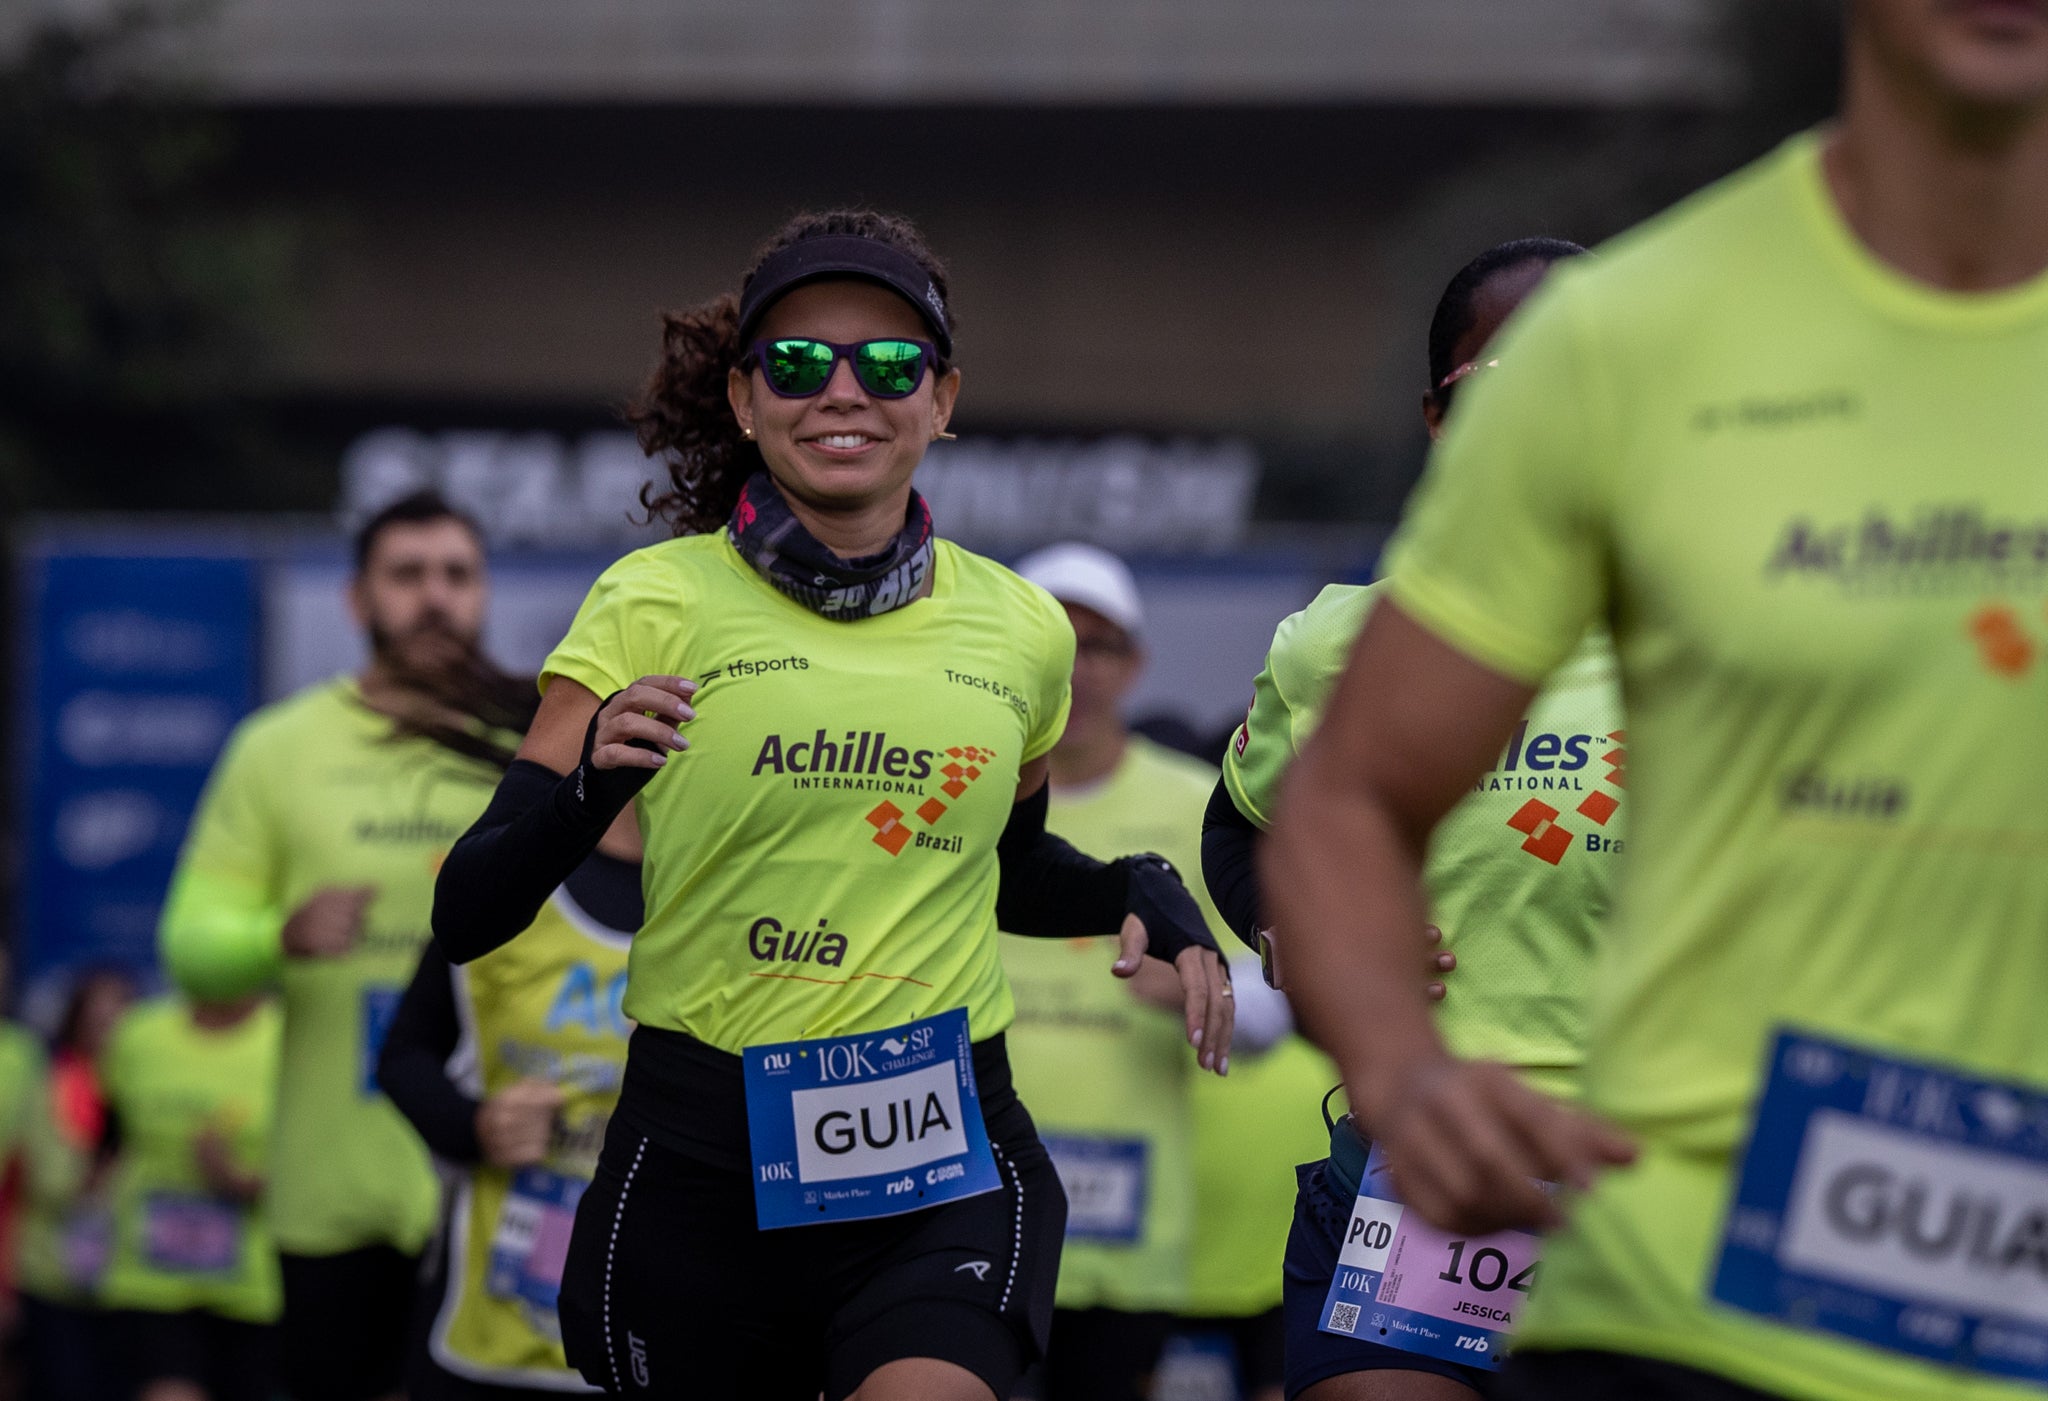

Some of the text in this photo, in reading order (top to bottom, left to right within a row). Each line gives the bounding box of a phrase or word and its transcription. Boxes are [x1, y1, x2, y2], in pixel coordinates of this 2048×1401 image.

[727, 655, 810, 678] tfsports
[751, 729, 934, 780] Achilles
[1496, 720, 1592, 772] les
[794, 777, 925, 796] INTERNATIONAL
[1474, 776, 1583, 792] NATIONAL
[915, 832, 962, 853] Brazil
[1586, 834, 1624, 854] Bra
[749, 917, 848, 967] Guia
[763, 1026, 934, 1082] nu 10K SP
[881, 1050, 936, 1072] CHALLENGE
[814, 1091, 952, 1155] GUIA
[759, 1162, 794, 1182] 10K
[886, 1176, 915, 1196] rvb
[1348, 1216, 1392, 1250] PCD
[1824, 1160, 2048, 1286] GUIA
[1339, 1271, 1376, 1294] 10K
[1453, 1301, 1512, 1323] JESSICA
[1392, 1319, 1418, 1334] Market
[1419, 1327, 1441, 1339] Place
[1455, 1335, 1489, 1352] rvb
